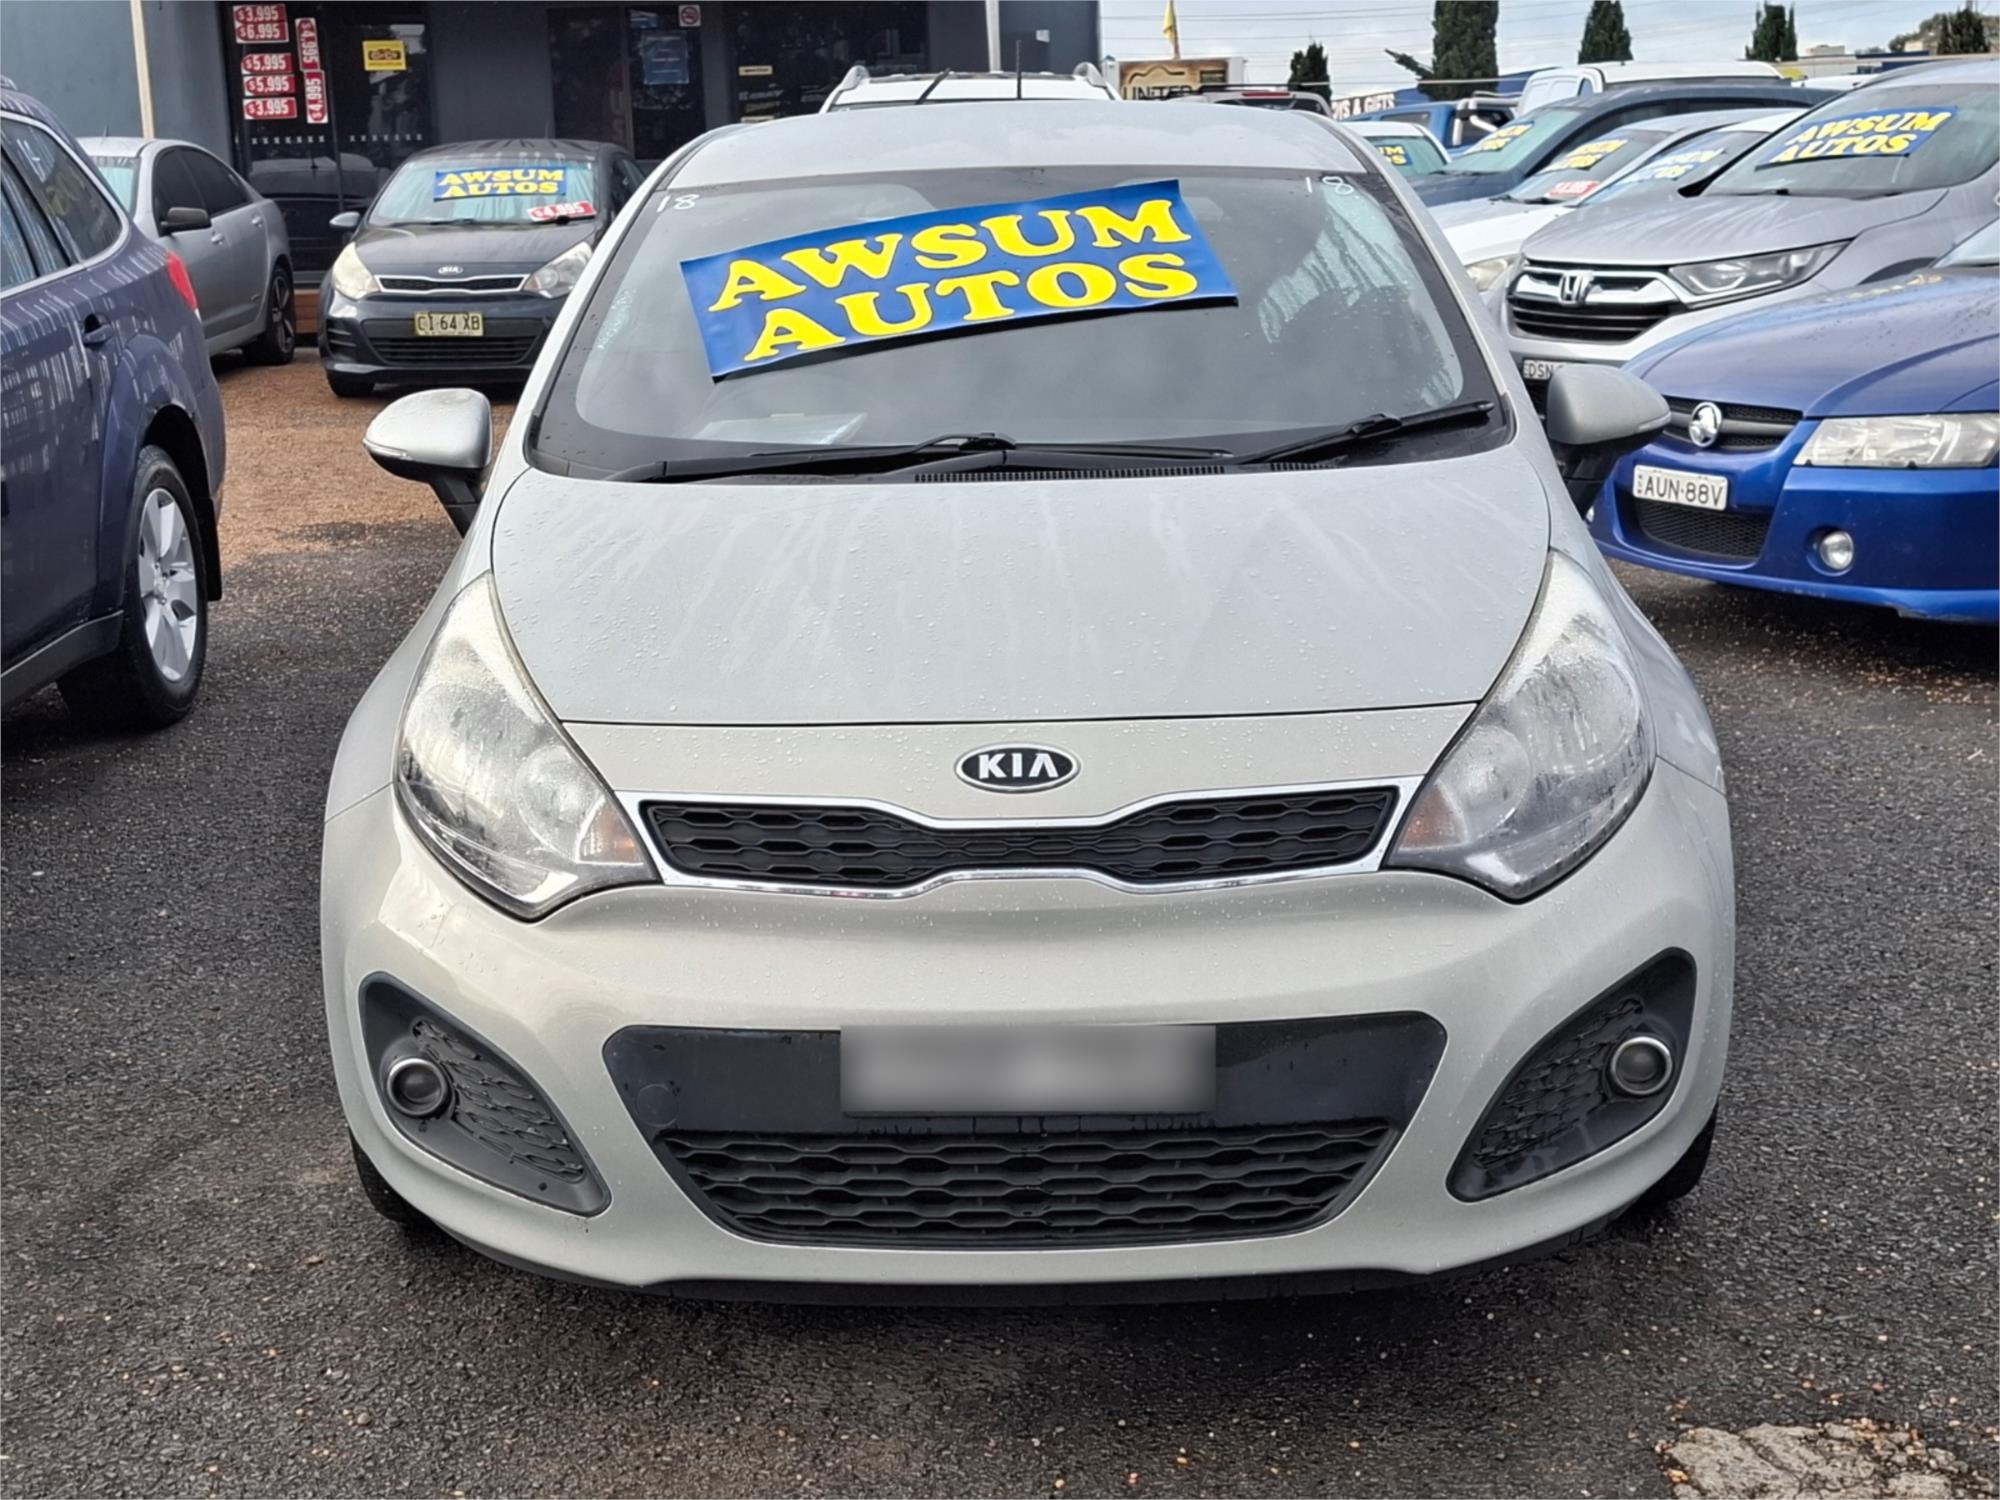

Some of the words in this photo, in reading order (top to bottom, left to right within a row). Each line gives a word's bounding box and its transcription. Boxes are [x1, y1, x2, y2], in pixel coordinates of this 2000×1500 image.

[237, 6, 279, 24] $3,995
[239, 24, 280, 39] $6,995
[246, 55, 286, 71] $5,995
[248, 76, 290, 93] $5,995
[248, 101, 289, 117] $3,995
[1784, 111, 1953, 145] AWSUM
[1769, 133, 1917, 163] AUTOS
[438, 168, 564, 186] AWSUM
[440, 181, 559, 198] AUTOS
[708, 199, 1192, 312] AWSUM
[743, 252, 1200, 362] AUTOS
[977, 752, 1060, 779] KIA
